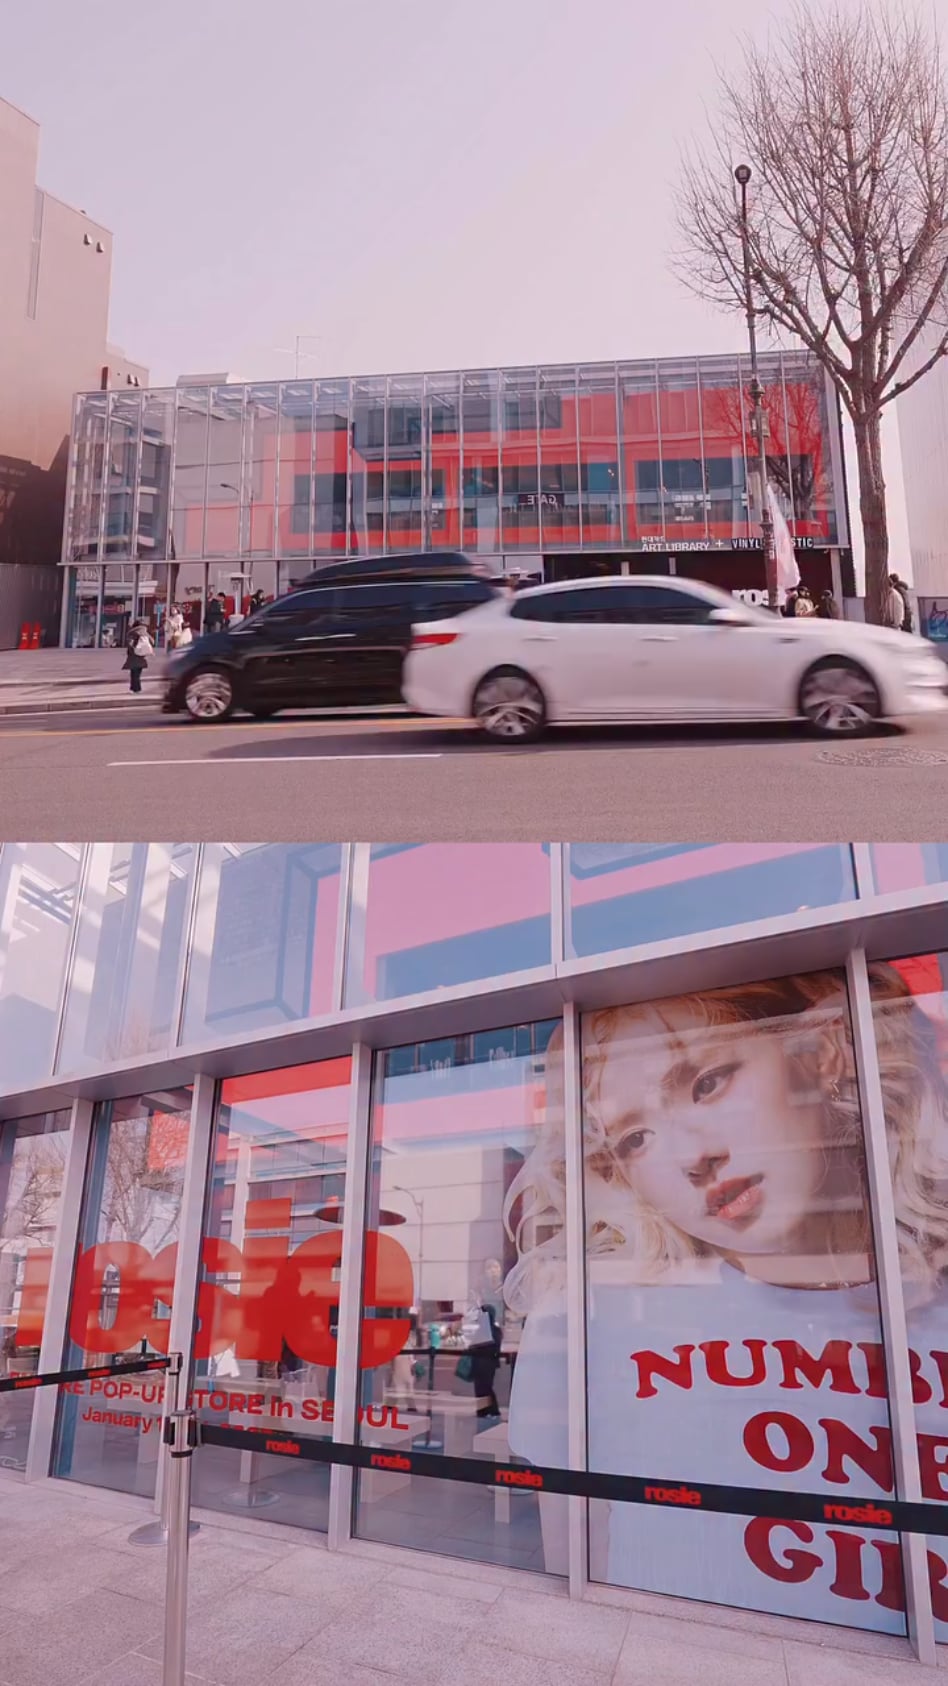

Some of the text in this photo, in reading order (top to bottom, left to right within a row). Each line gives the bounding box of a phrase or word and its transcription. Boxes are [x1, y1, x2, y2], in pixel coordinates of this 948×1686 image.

[642, 543, 663, 552] ART
[666, 542, 709, 551] LIBRARY
[732, 538, 761, 549] VINYL
[90, 1380, 165, 1404] POP-U
[82, 1406, 152, 1433] January
[495, 1468, 543, 1488] rosie
[644, 1485, 702, 1506] rosie
[823, 1502, 893, 1526] rosie
